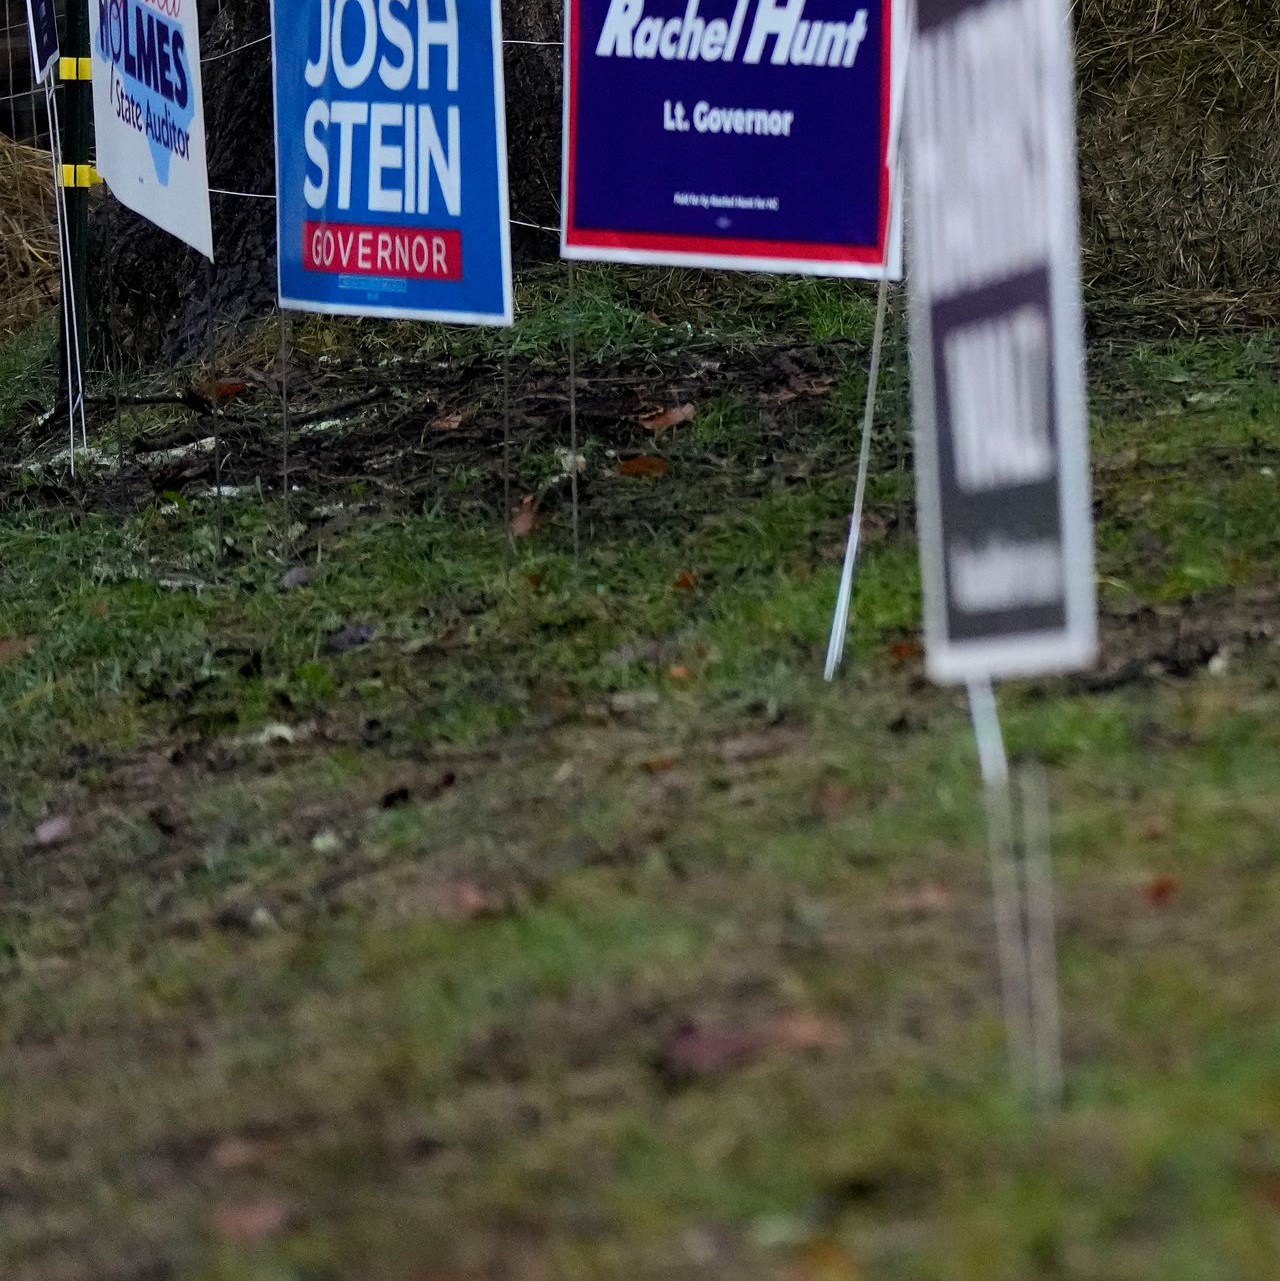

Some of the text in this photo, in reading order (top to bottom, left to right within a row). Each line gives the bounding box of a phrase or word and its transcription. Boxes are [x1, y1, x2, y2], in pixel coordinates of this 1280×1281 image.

[116, 78, 190, 160] State Auditor
[664, 99, 794, 137] Lt. Governor
[302, 98, 461, 217] STEIN
[311, 229, 448, 274] GOVERNOR
